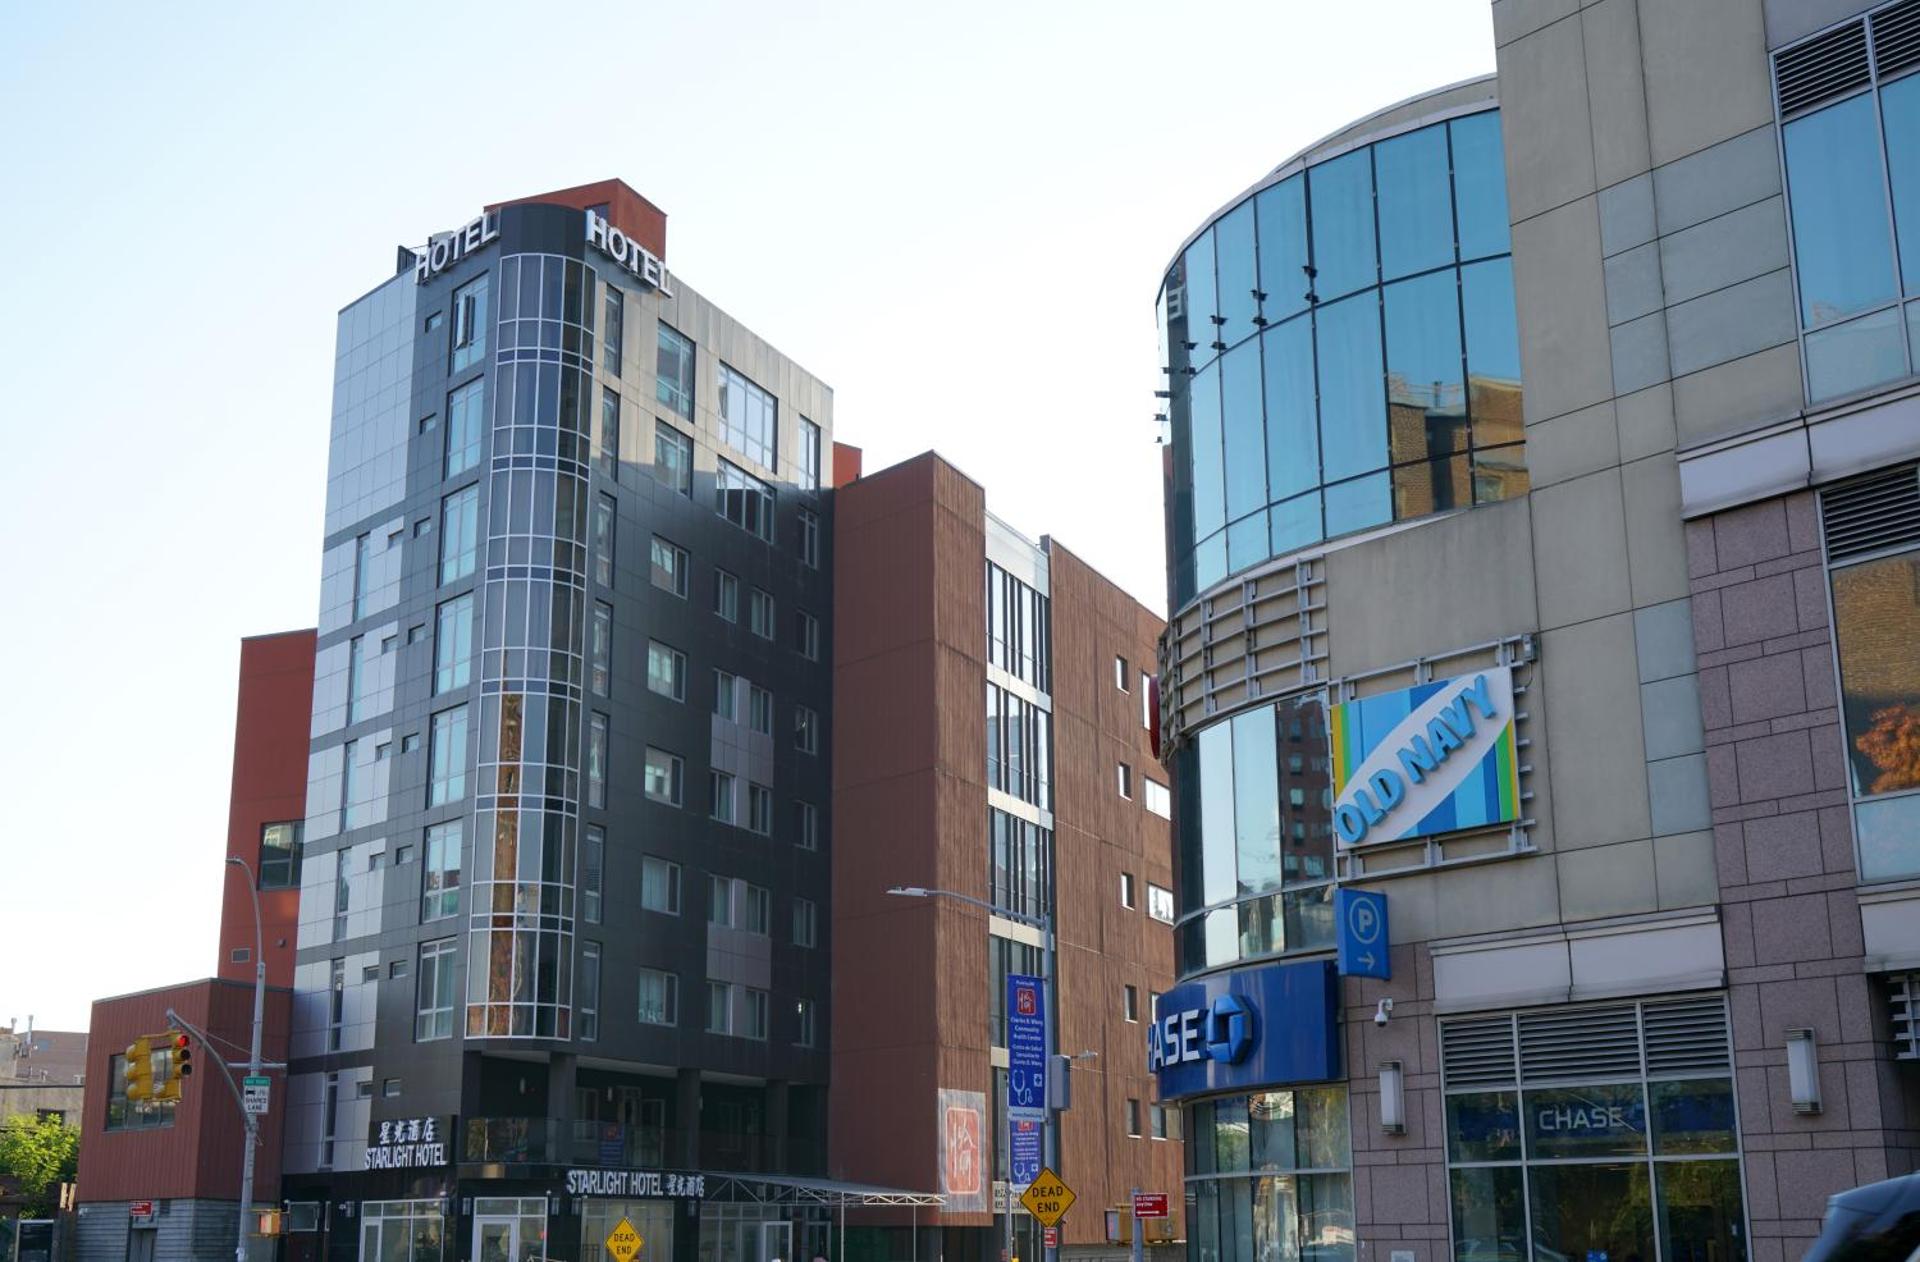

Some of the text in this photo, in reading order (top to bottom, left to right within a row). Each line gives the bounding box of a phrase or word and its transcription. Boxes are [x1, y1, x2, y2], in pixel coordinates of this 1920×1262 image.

[414, 211, 500, 284] HOTEL
[586, 209, 672, 298] HOTEL
[1335, 674, 1496, 843] OLD NAVY
[1358, 908, 1373, 933] P
[379, 1117, 434, 1145] 星光酒店
[1539, 1107, 1624, 1130] CHASE
[364, 1143, 448, 1169] STARLIGHT HOTEL
[566, 1169, 663, 1196] STARLIGHT HOTEL
[666, 1174, 705, 1198] 星光酒店
[1032, 1186, 1063, 1198] DEAD
[1038, 1202, 1060, 1213] END
[613, 1233, 635, 1242] DEAD
[616, 1246, 632, 1255] END
